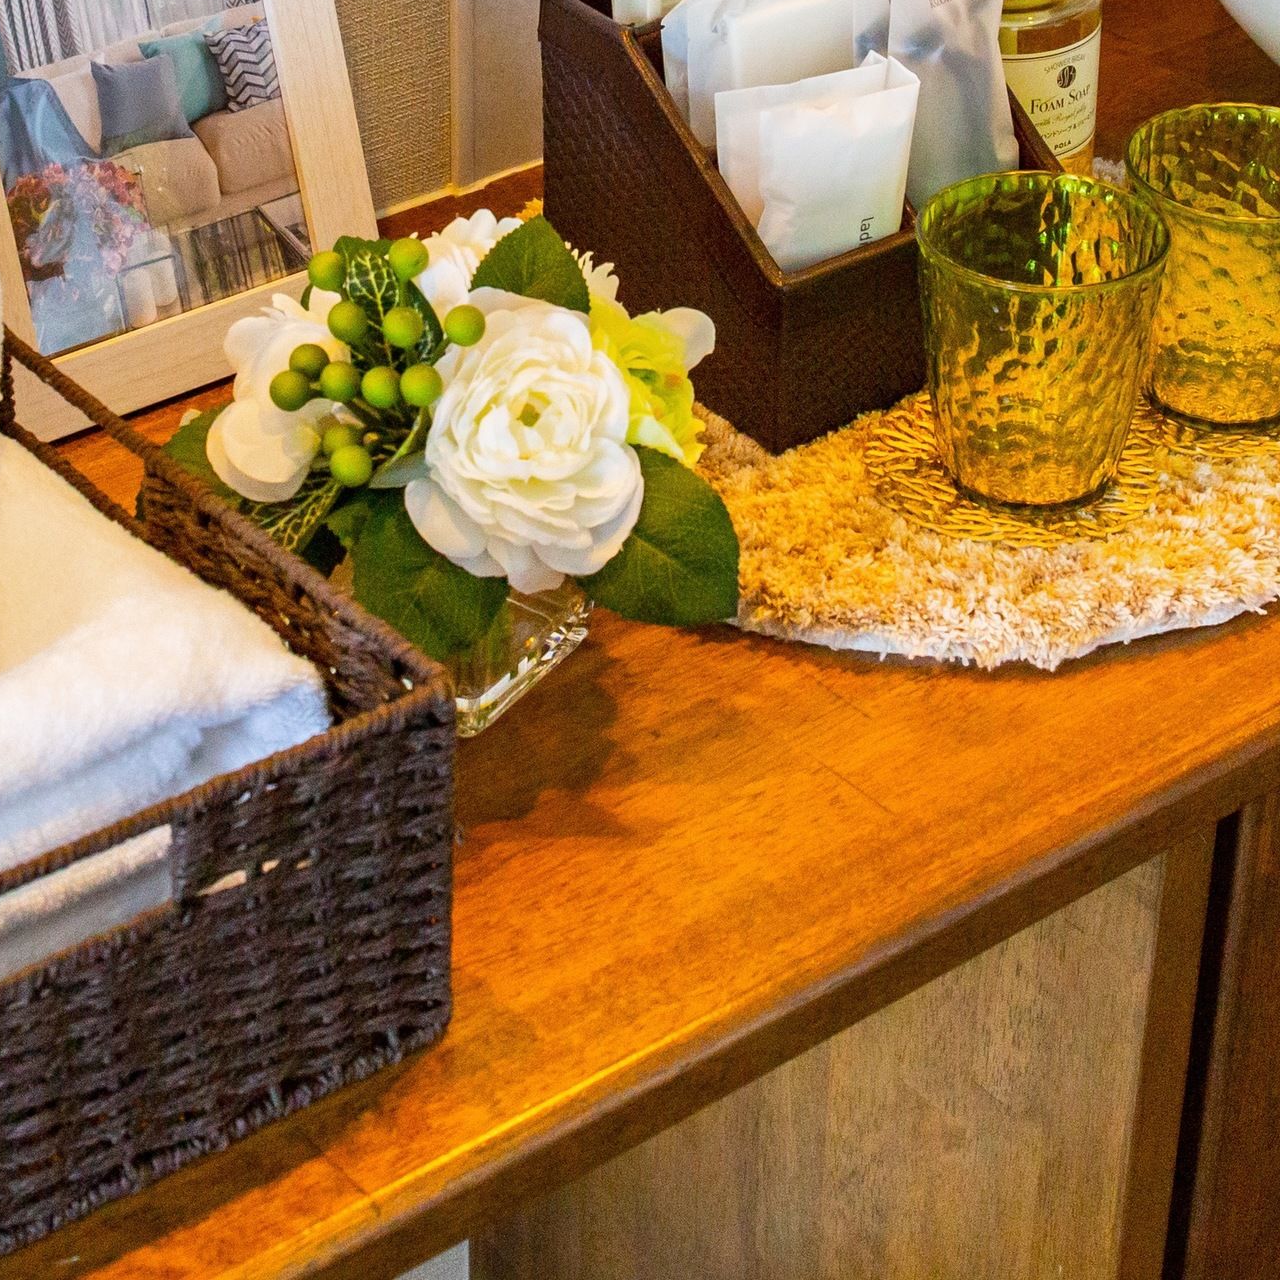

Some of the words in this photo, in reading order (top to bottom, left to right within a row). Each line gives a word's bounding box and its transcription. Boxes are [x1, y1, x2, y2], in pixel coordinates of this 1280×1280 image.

[1030, 98, 1064, 115] FOAM
[1068, 84, 1091, 106] SOAP
[1054, 139, 1071, 150] POLA
